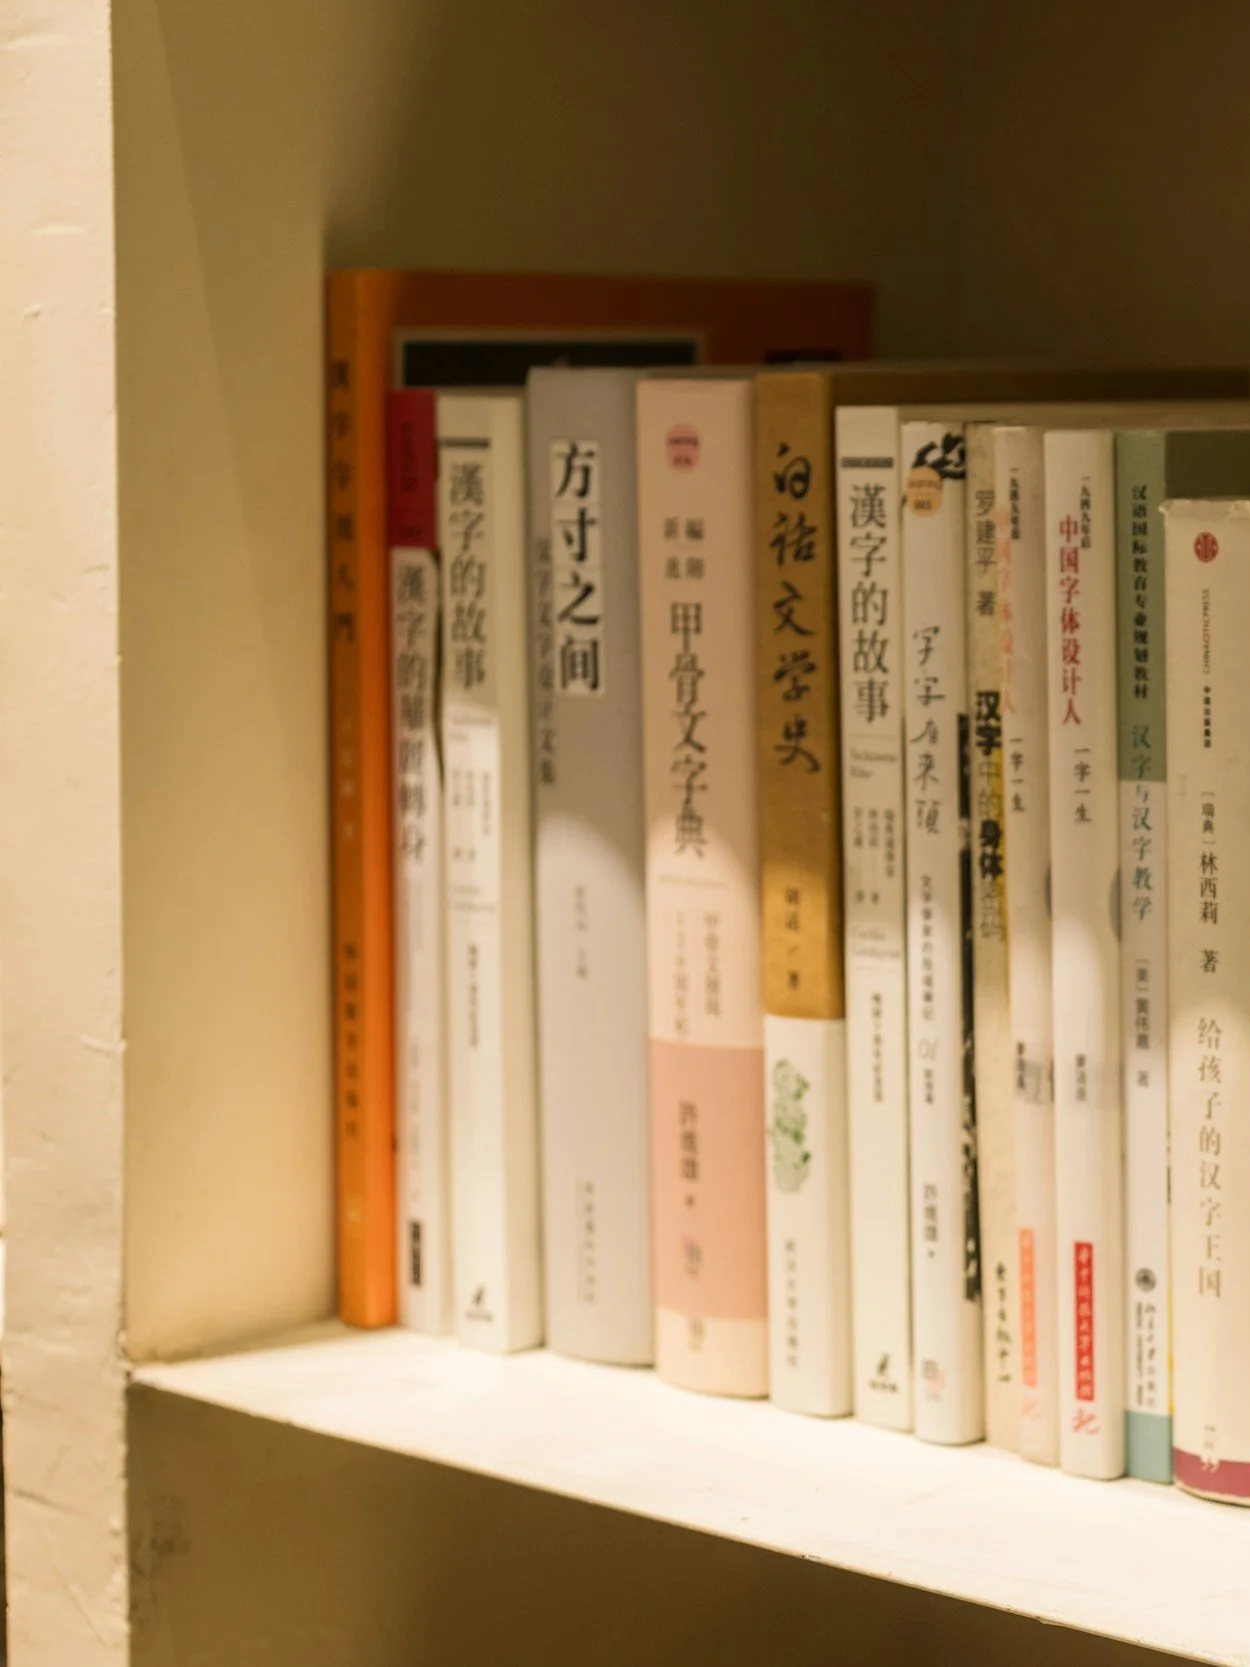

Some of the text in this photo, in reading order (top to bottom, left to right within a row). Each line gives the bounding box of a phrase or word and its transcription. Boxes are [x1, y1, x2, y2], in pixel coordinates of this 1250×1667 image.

[449, 462, 488, 691] 漢字的故事
[554, 442, 600, 692] 方寸之间
[850, 482, 889, 724] 漢字的故事
[975, 490, 996, 616] 罗建平 著
[1058, 514, 1082, 727] 中国字体设计人
[1079, 477, 1092, 549] 一九四九年后
[1132, 484, 1149, 701] 汉语国际教育专业规划教材
[669, 601, 709, 858] 甲骨文字典
[1073, 746, 1092, 824] 一字一生
[1130, 724, 1154, 922] 汉字与汉字教学
[1200, 949, 1218, 974] 著
[1197, 1017, 1224, 1298] 给孩子的汉字王国
